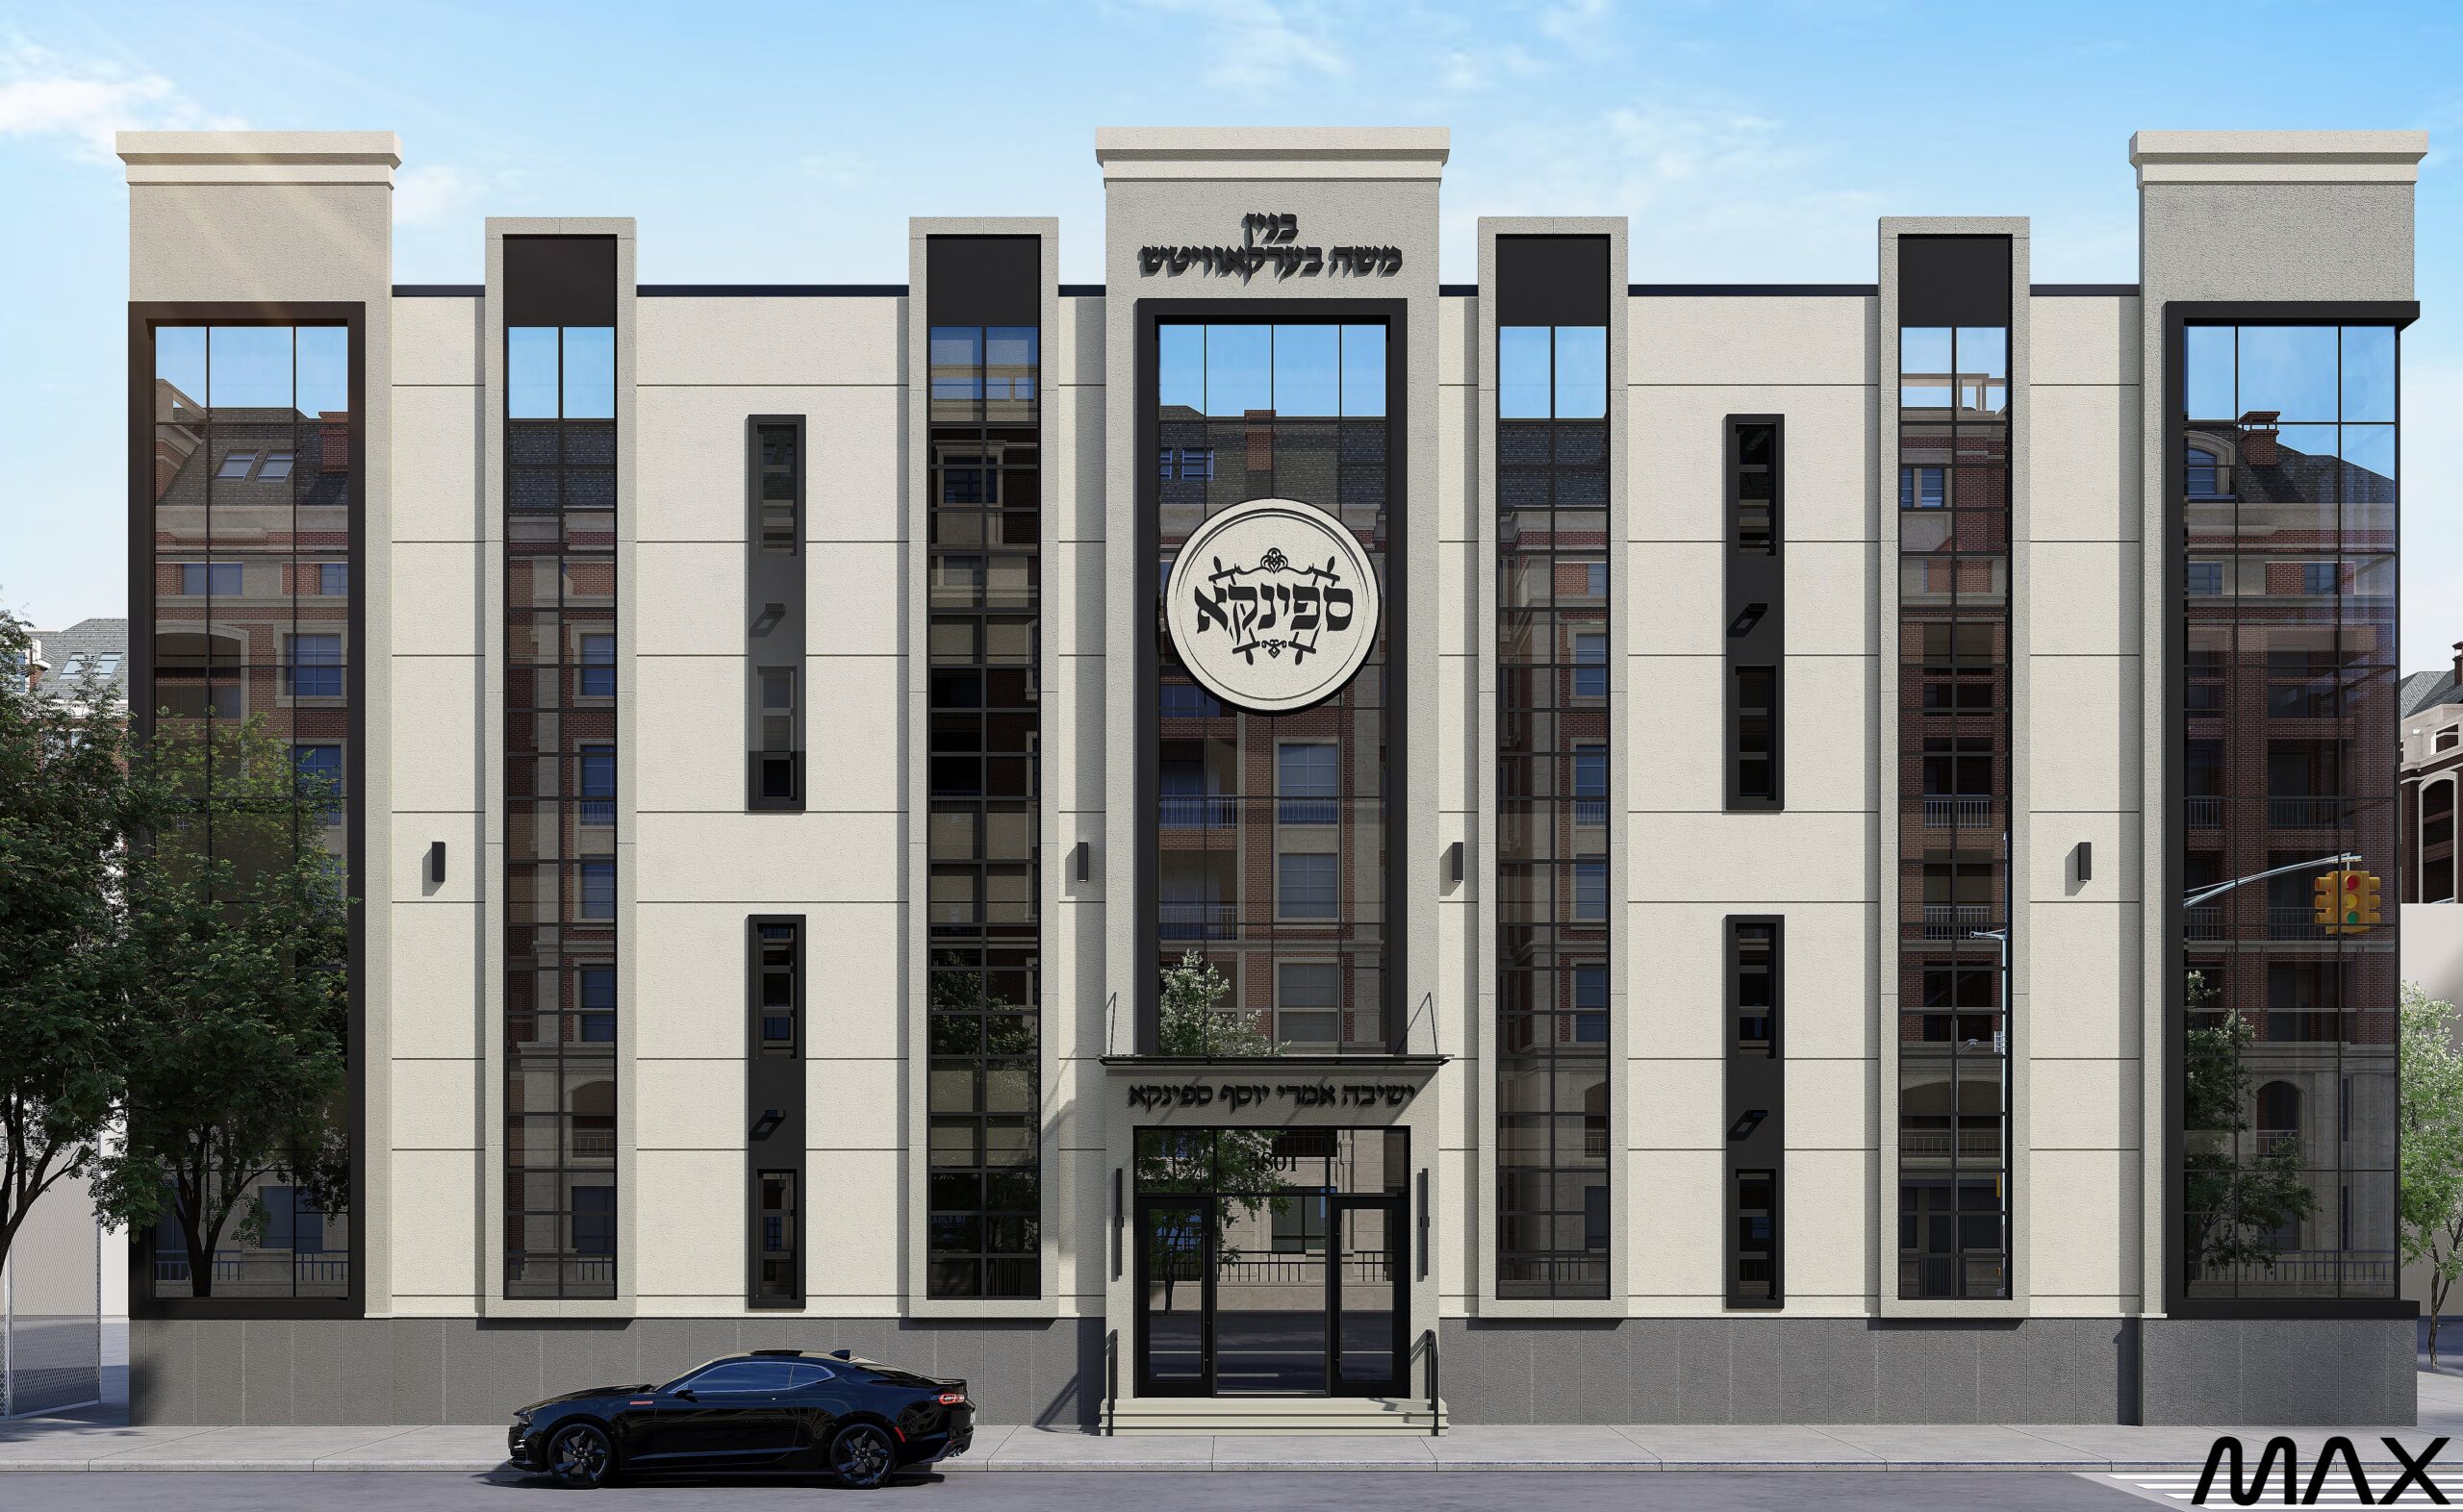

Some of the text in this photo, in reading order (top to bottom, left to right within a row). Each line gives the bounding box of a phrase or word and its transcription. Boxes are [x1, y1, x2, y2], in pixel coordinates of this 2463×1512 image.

[1242, 212, 1299, 250] בנין
[1329, 244, 1404, 278] משה
[1194, 582, 1354, 646] ספינקא
[1128, 1084, 1416, 1116] ישיבה אמרי יוסף ספינקא
[1248, 1152, 1297, 1172] 5801
